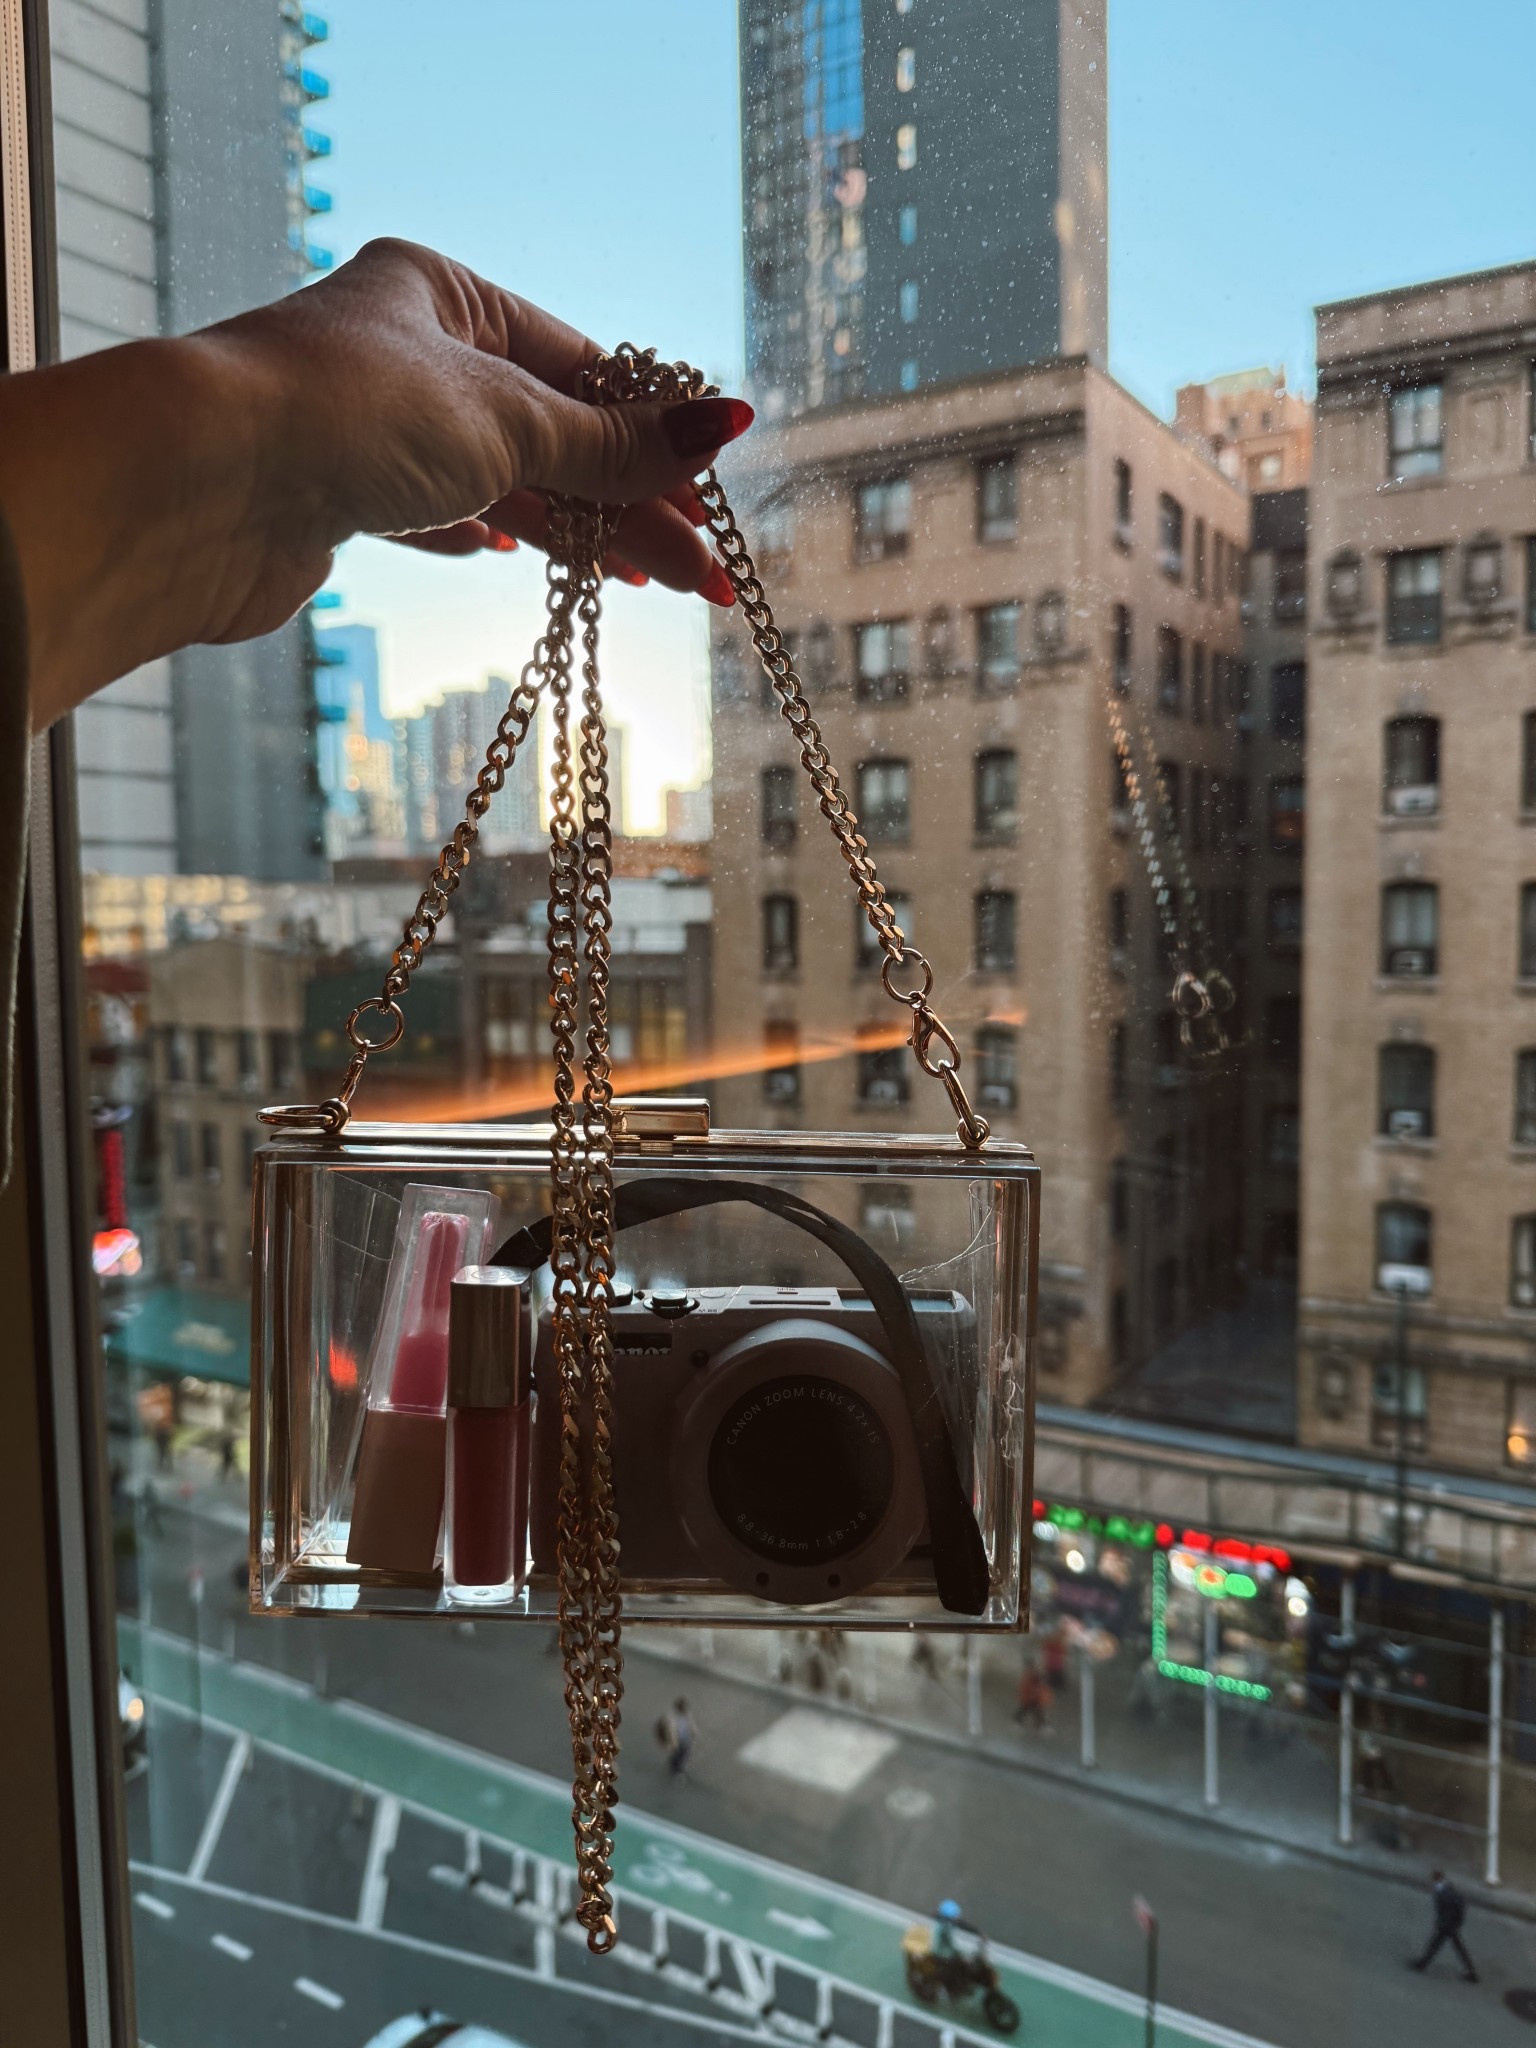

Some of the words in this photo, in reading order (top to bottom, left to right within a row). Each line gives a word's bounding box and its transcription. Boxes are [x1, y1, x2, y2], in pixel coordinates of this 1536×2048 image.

[727, 1403, 761, 1445] CANON
[763, 1387, 804, 1407] ZOOM
[810, 1387, 844, 1406] LENS
[867, 1430, 882, 1444] IS
